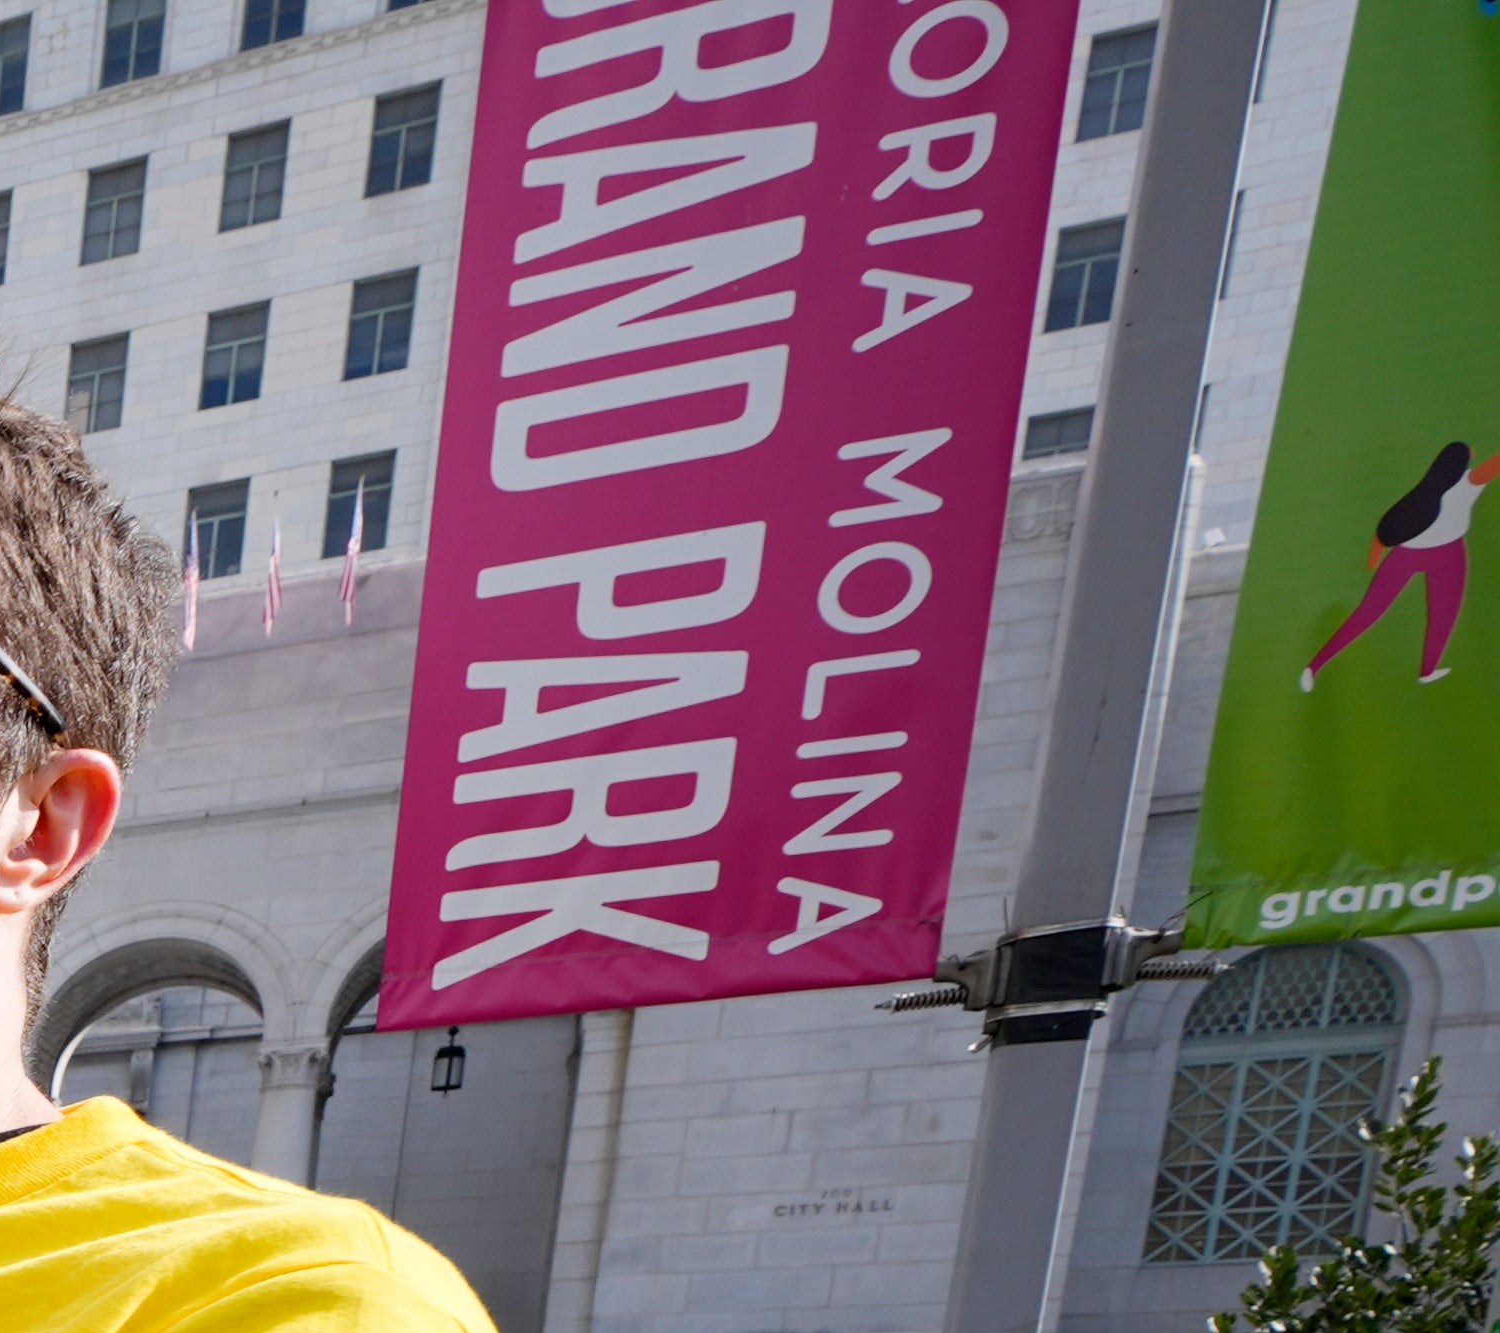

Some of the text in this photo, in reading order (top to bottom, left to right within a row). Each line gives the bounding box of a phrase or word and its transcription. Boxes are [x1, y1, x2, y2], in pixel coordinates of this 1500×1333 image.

[431, 0, 833, 992] RAND PARK
[766, 0, 1010, 957] ORIA MOLINA
[1259, 870, 1500, 930] grandp
[773, 1199, 895, 1217] CITY HALL
